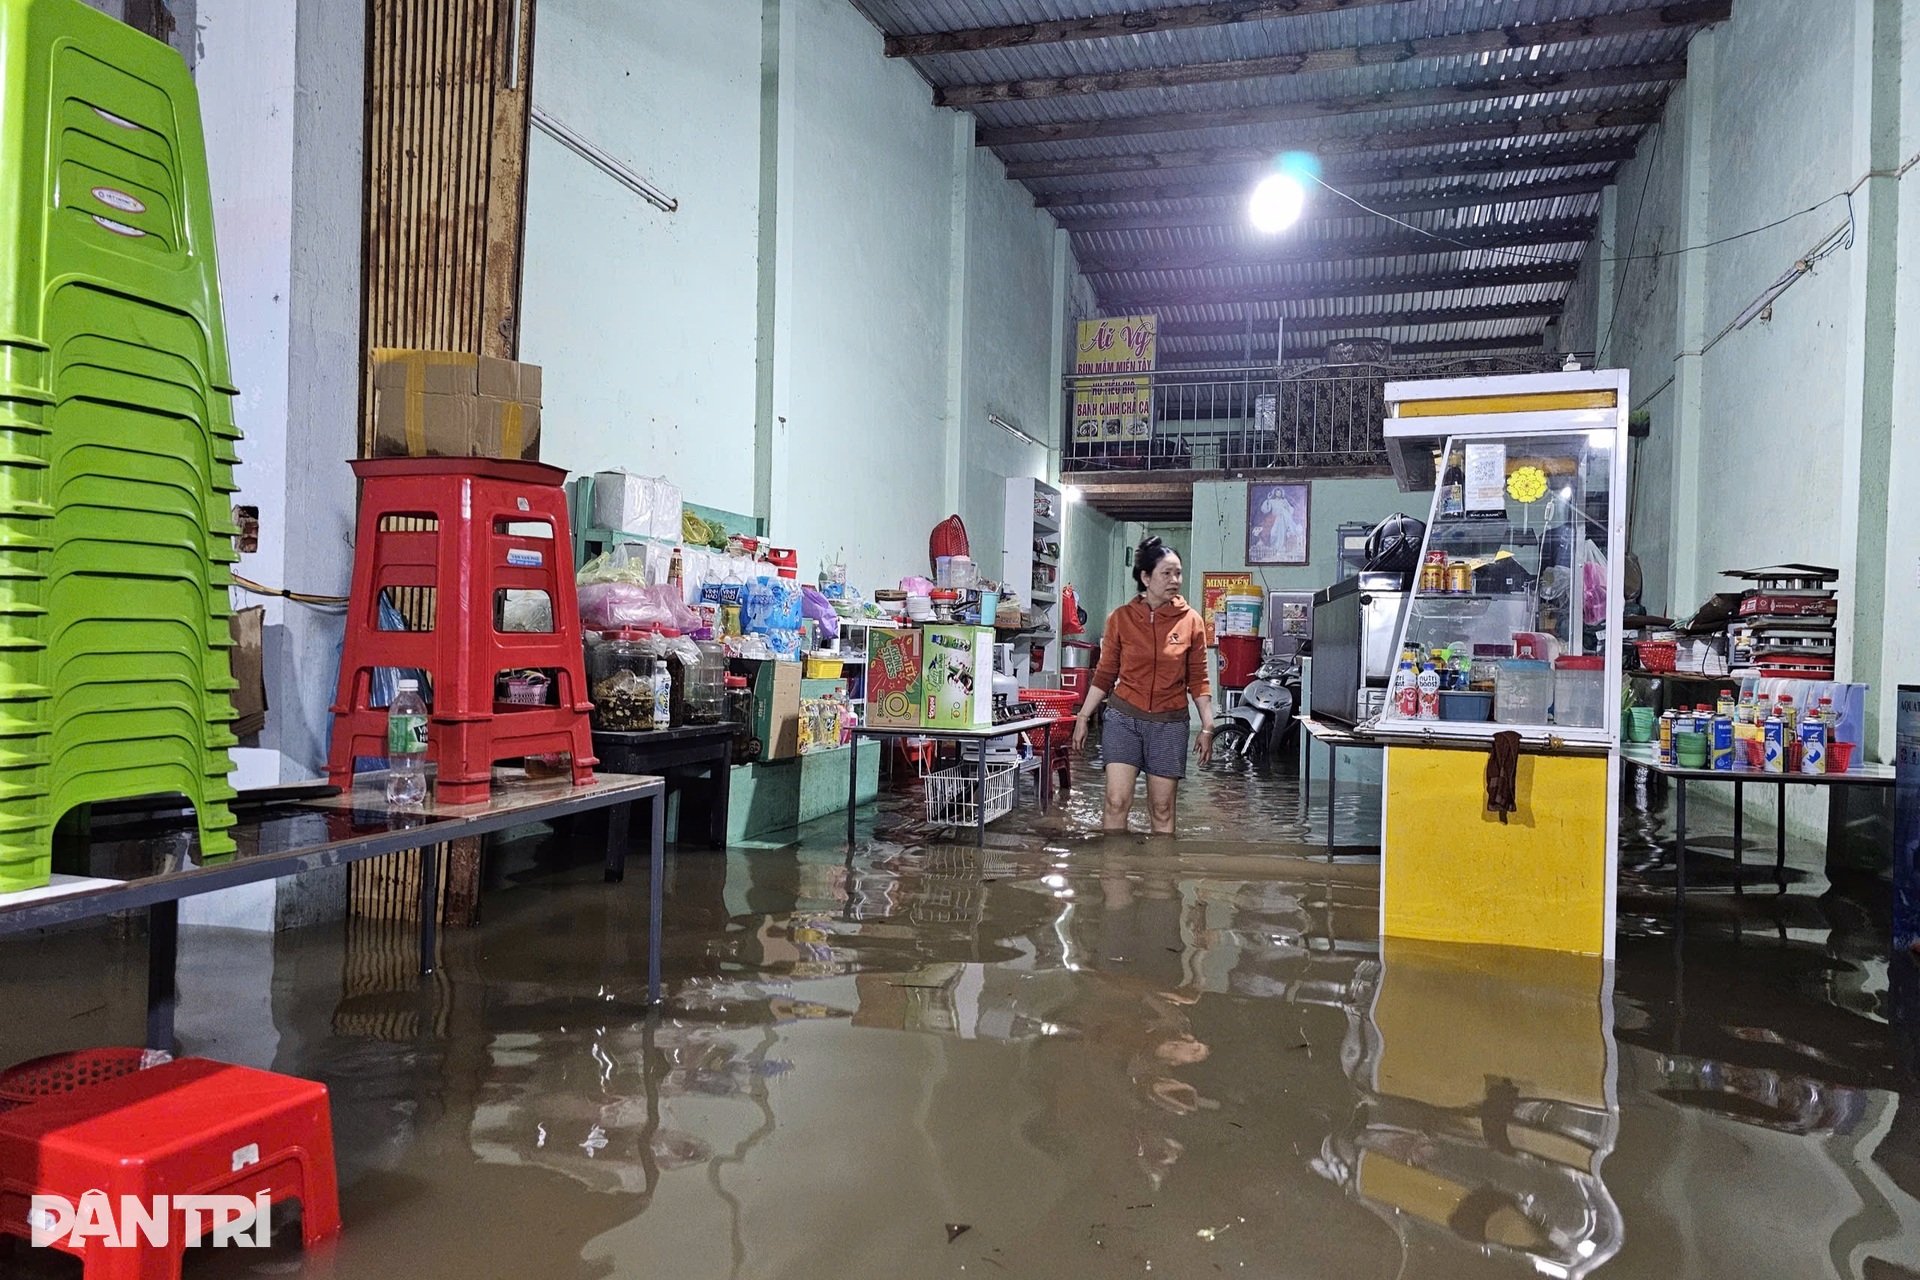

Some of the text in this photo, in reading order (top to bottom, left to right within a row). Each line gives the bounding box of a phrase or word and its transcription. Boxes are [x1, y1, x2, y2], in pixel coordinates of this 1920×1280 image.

[1080, 322, 1115, 353] Ái
[1077, 400, 1098, 417] BÁNH
[1139, 398, 1149, 414] CÁ
[1206, 578, 1230, 588] MINH
[882, 647, 896, 679] STRESS
[890, 645, 904, 672] KHÔNG
[904, 660, 918, 677] TẾT
